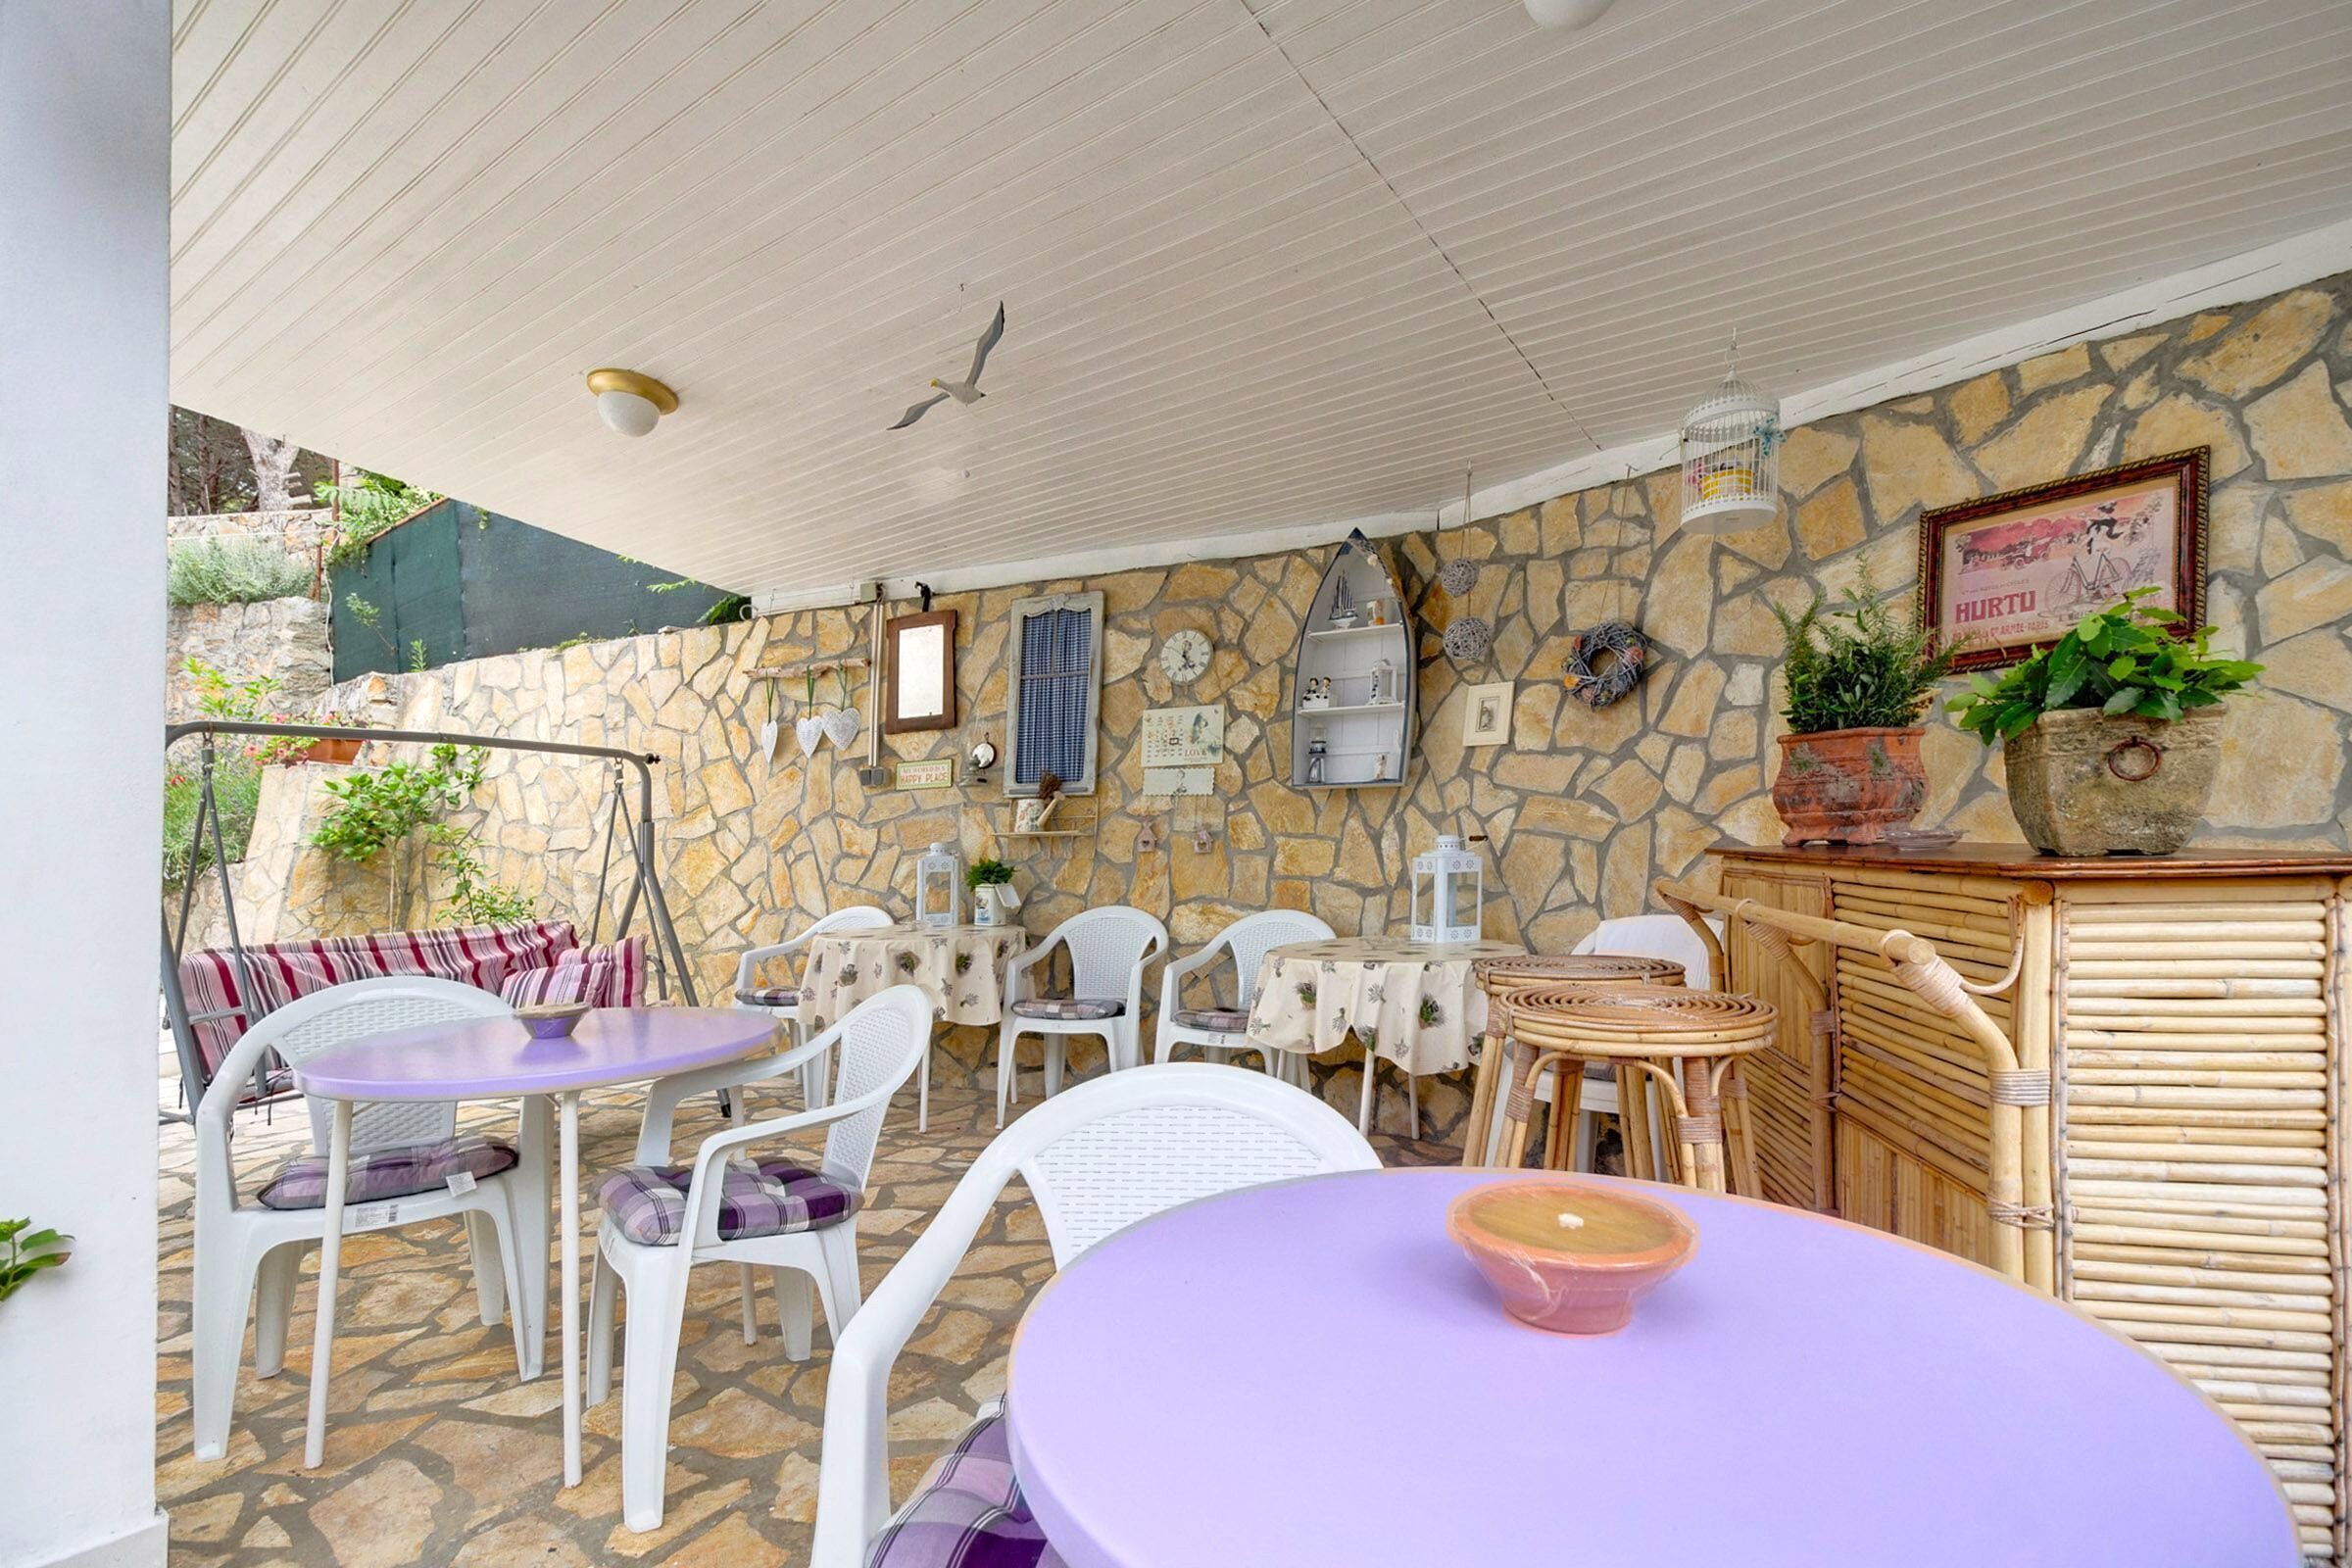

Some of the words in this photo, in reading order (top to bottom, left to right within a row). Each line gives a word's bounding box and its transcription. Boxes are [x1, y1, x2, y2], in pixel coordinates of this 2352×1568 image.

[1955, 590, 2035, 623] HURTU
[1184, 749, 1207, 758] LOVE
[900, 773, 922, 785] HAPPY
[925, 771, 949, 783] PLACE
